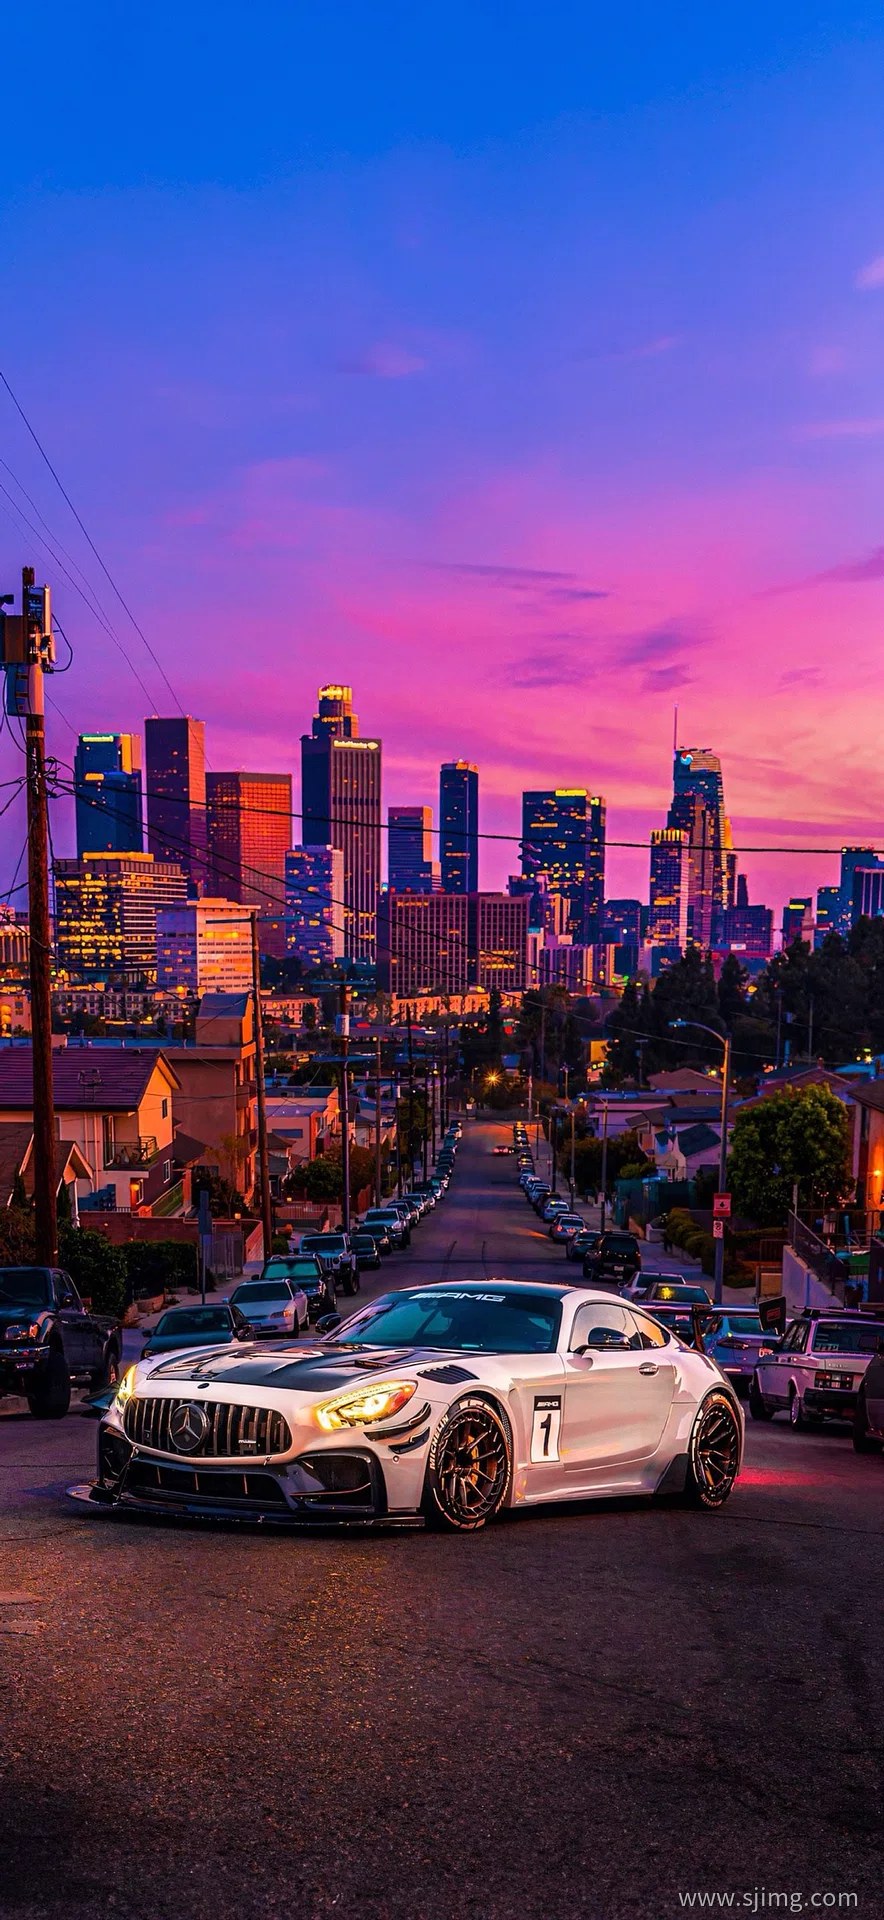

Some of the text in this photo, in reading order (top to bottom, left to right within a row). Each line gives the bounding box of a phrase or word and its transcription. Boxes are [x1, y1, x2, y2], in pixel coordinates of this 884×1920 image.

[436, 1292, 506, 1303] AMG
[429, 1414, 449, 1470] MICHELIN
[540, 1413, 552, 1457] 1
